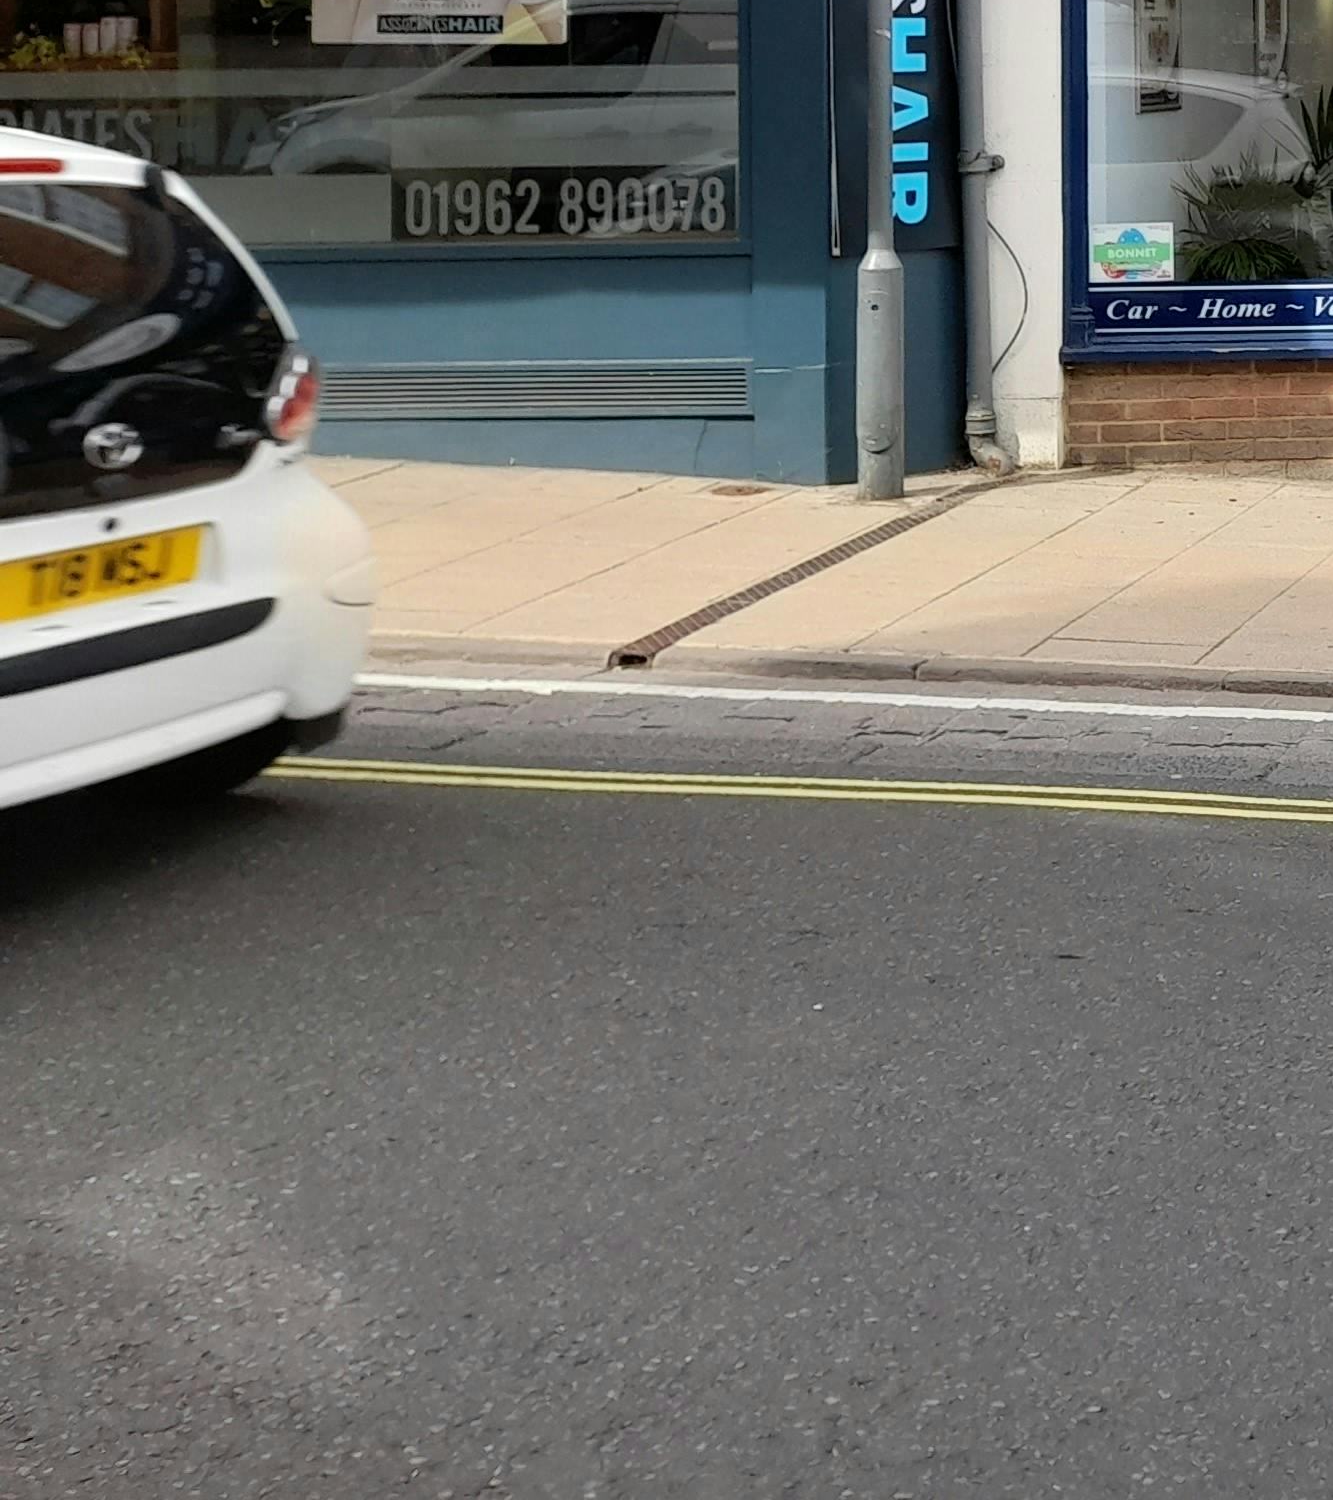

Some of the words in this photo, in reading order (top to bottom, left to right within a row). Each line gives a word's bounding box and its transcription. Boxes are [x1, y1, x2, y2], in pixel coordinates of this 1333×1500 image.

[404, 179, 541, 236] 01962
[558, 177, 727, 236] 890078
[1107, 248, 1157, 259] BONNET
[1106, 299, 1159, 322] Car
[1199, 299, 1276, 320] Home
